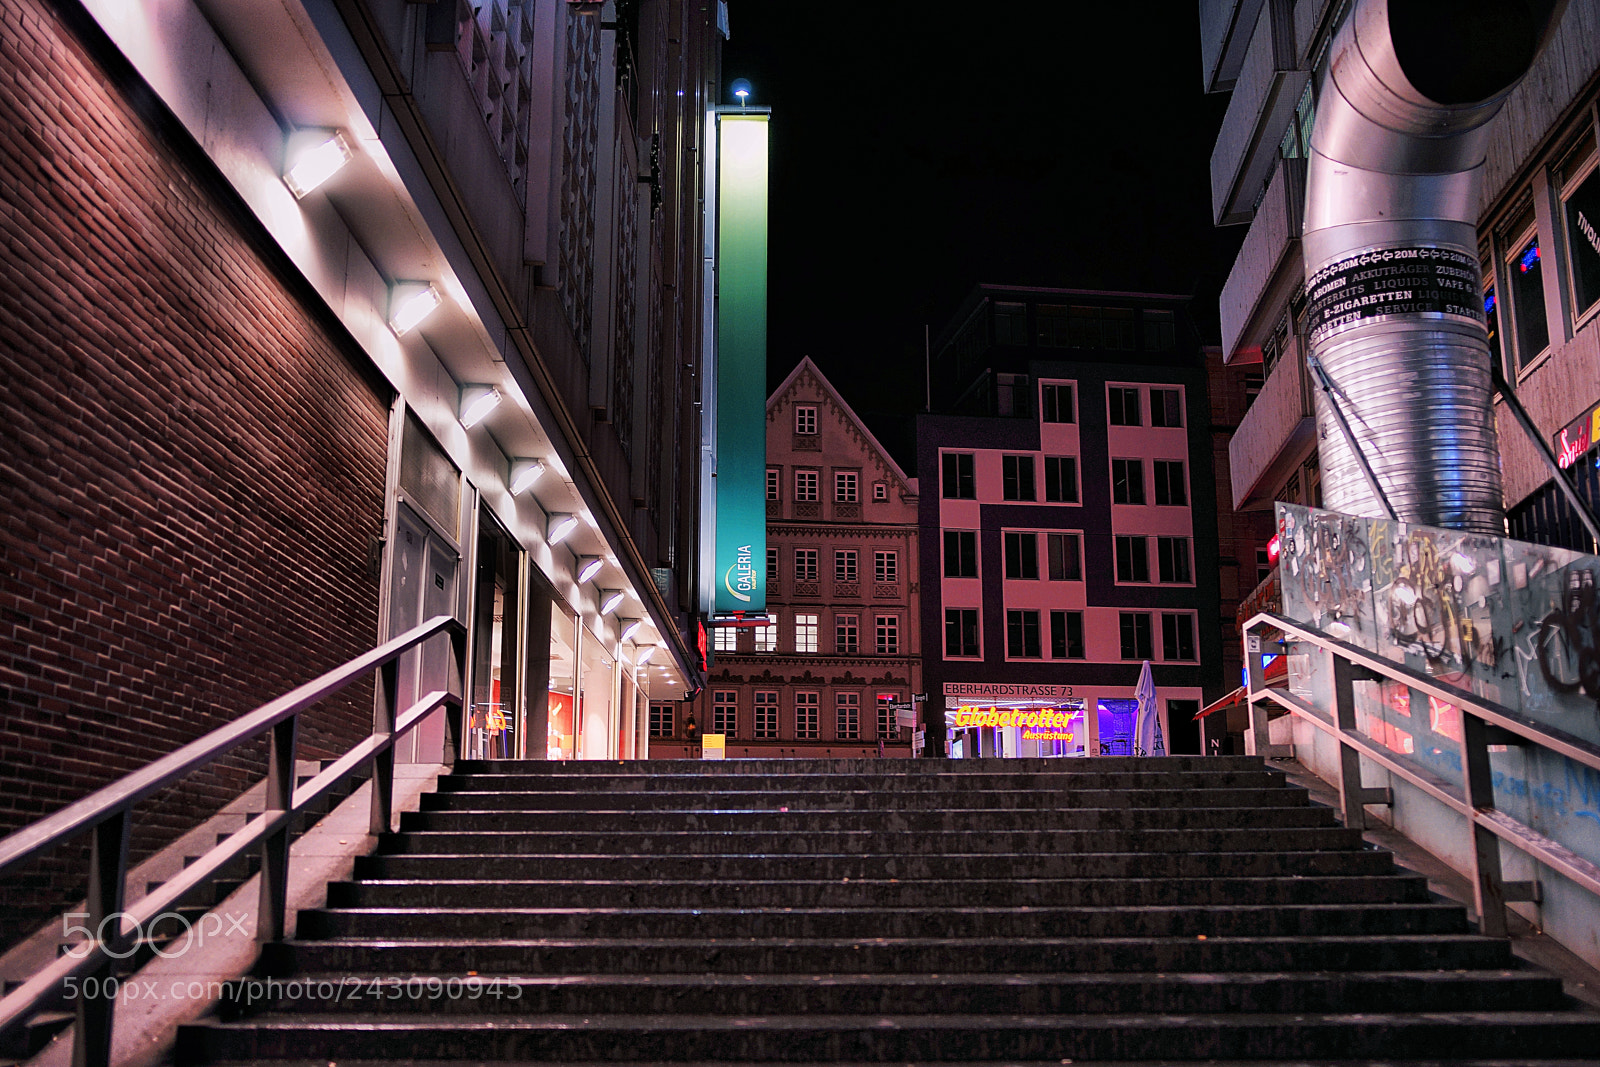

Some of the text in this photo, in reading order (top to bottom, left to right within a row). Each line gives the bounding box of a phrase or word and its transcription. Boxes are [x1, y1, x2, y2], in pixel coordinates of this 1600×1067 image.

[1338, 258, 1359, 272] 20M
[1394, 249, 1418, 260] 20M
[1313, 276, 1347, 301] AROMEN
[1352, 263, 1430, 283] AKKUTRÄGER
[1374, 277, 1430, 290] LIQUIDS
[1437, 278, 1464, 290] VAPE
[1324, 290, 1413, 319] E-ZIGARETTEN
[1376, 302, 1433, 315] SERVICE
[737, 544, 751, 591] GALERIA
[945, 684, 1073, 696] EBERHARDSTRASSE 73
[954, 704, 1073, 728] Globetrotter
[1022, 729, 1074, 743] Ausrüstung
